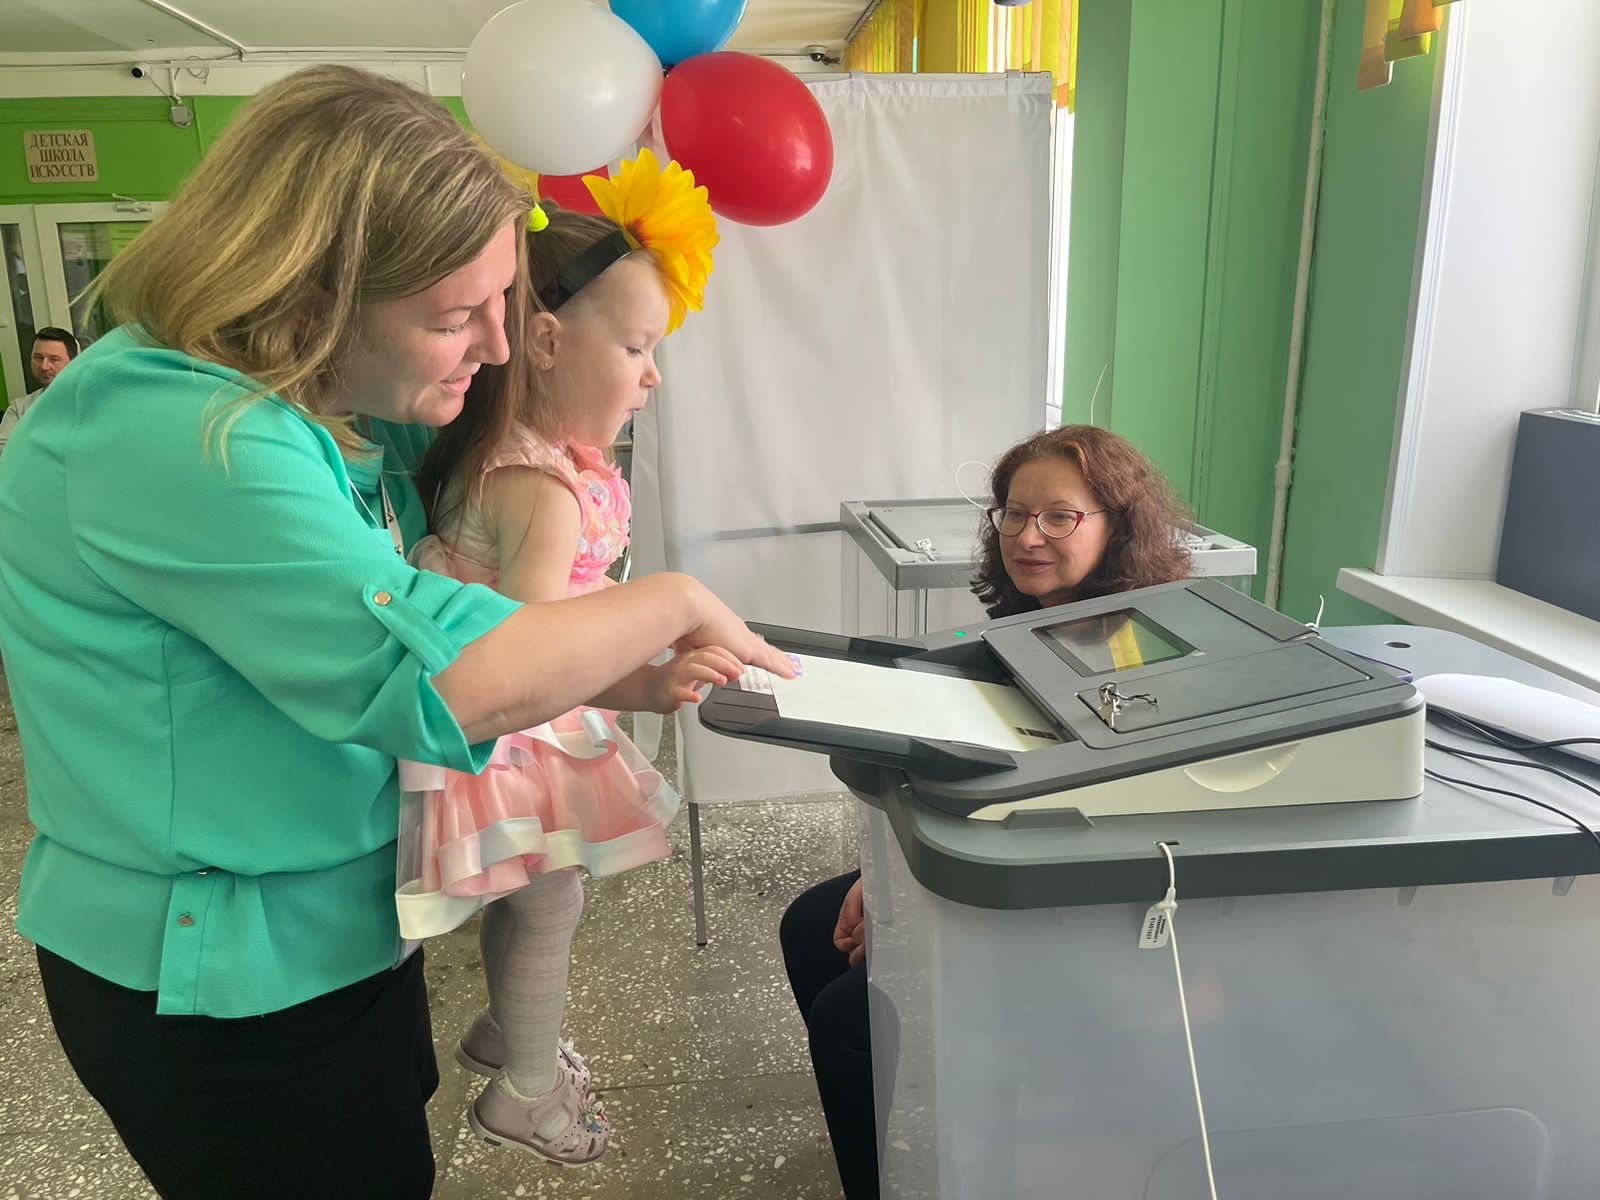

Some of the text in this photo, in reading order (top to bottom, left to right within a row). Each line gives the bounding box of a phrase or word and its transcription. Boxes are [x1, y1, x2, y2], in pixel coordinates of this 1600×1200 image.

[31, 133, 88, 149] ДЕТСКАЯ
[40, 149, 85, 162] ШКОЛА
[31, 164, 95, 178] ИСКУССТВ
